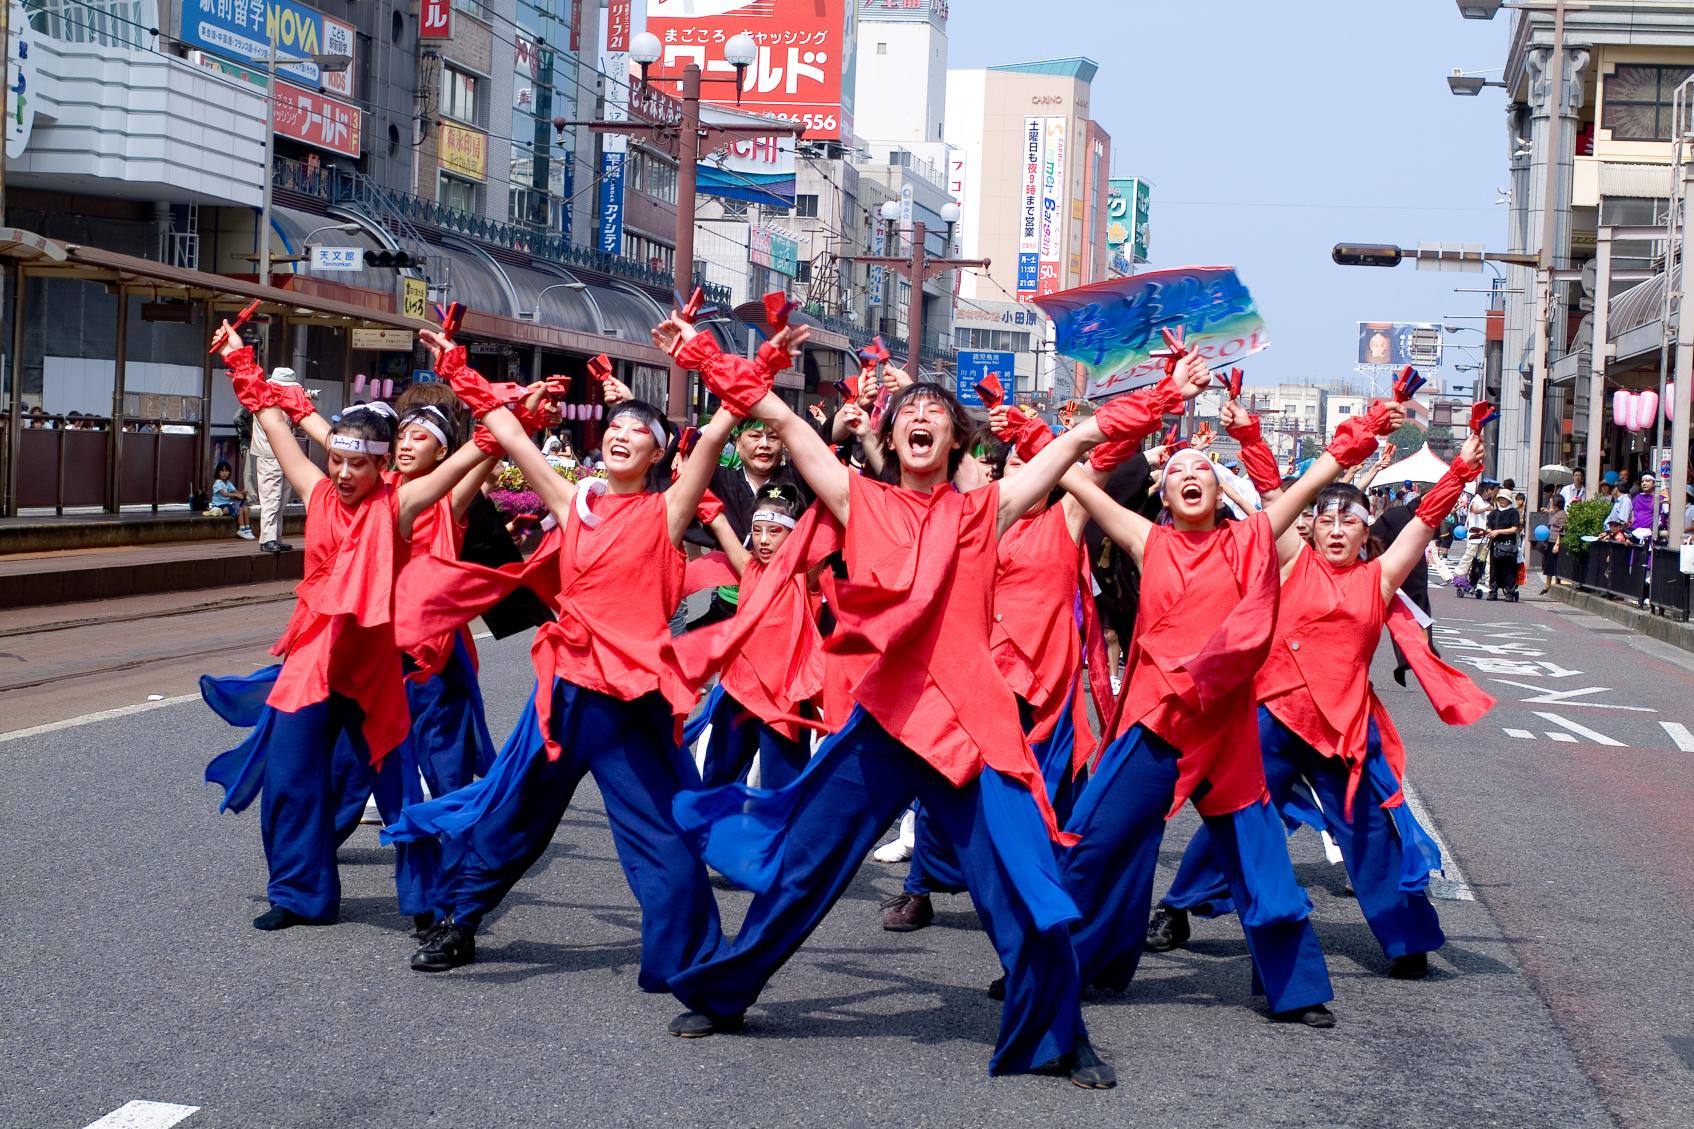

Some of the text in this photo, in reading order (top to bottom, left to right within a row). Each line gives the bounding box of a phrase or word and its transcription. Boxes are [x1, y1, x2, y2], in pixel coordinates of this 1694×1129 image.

[266, 2, 319, 54] NOVA
[665, 27, 726, 43] まごころ
[664, 45, 827, 94] ワールド
[1032, 96, 1062, 105] CARINO
[298, 96, 348, 146] ワールド
[1025, 120, 1039, 238] 土曜日も夜9時まで営業
[604, 204, 619, 252] アイシティ
[320, 250, 355, 261] 天文館
[1019, 279, 1036, 287] 21:00
[1002, 310, 1037, 325] 小田原
